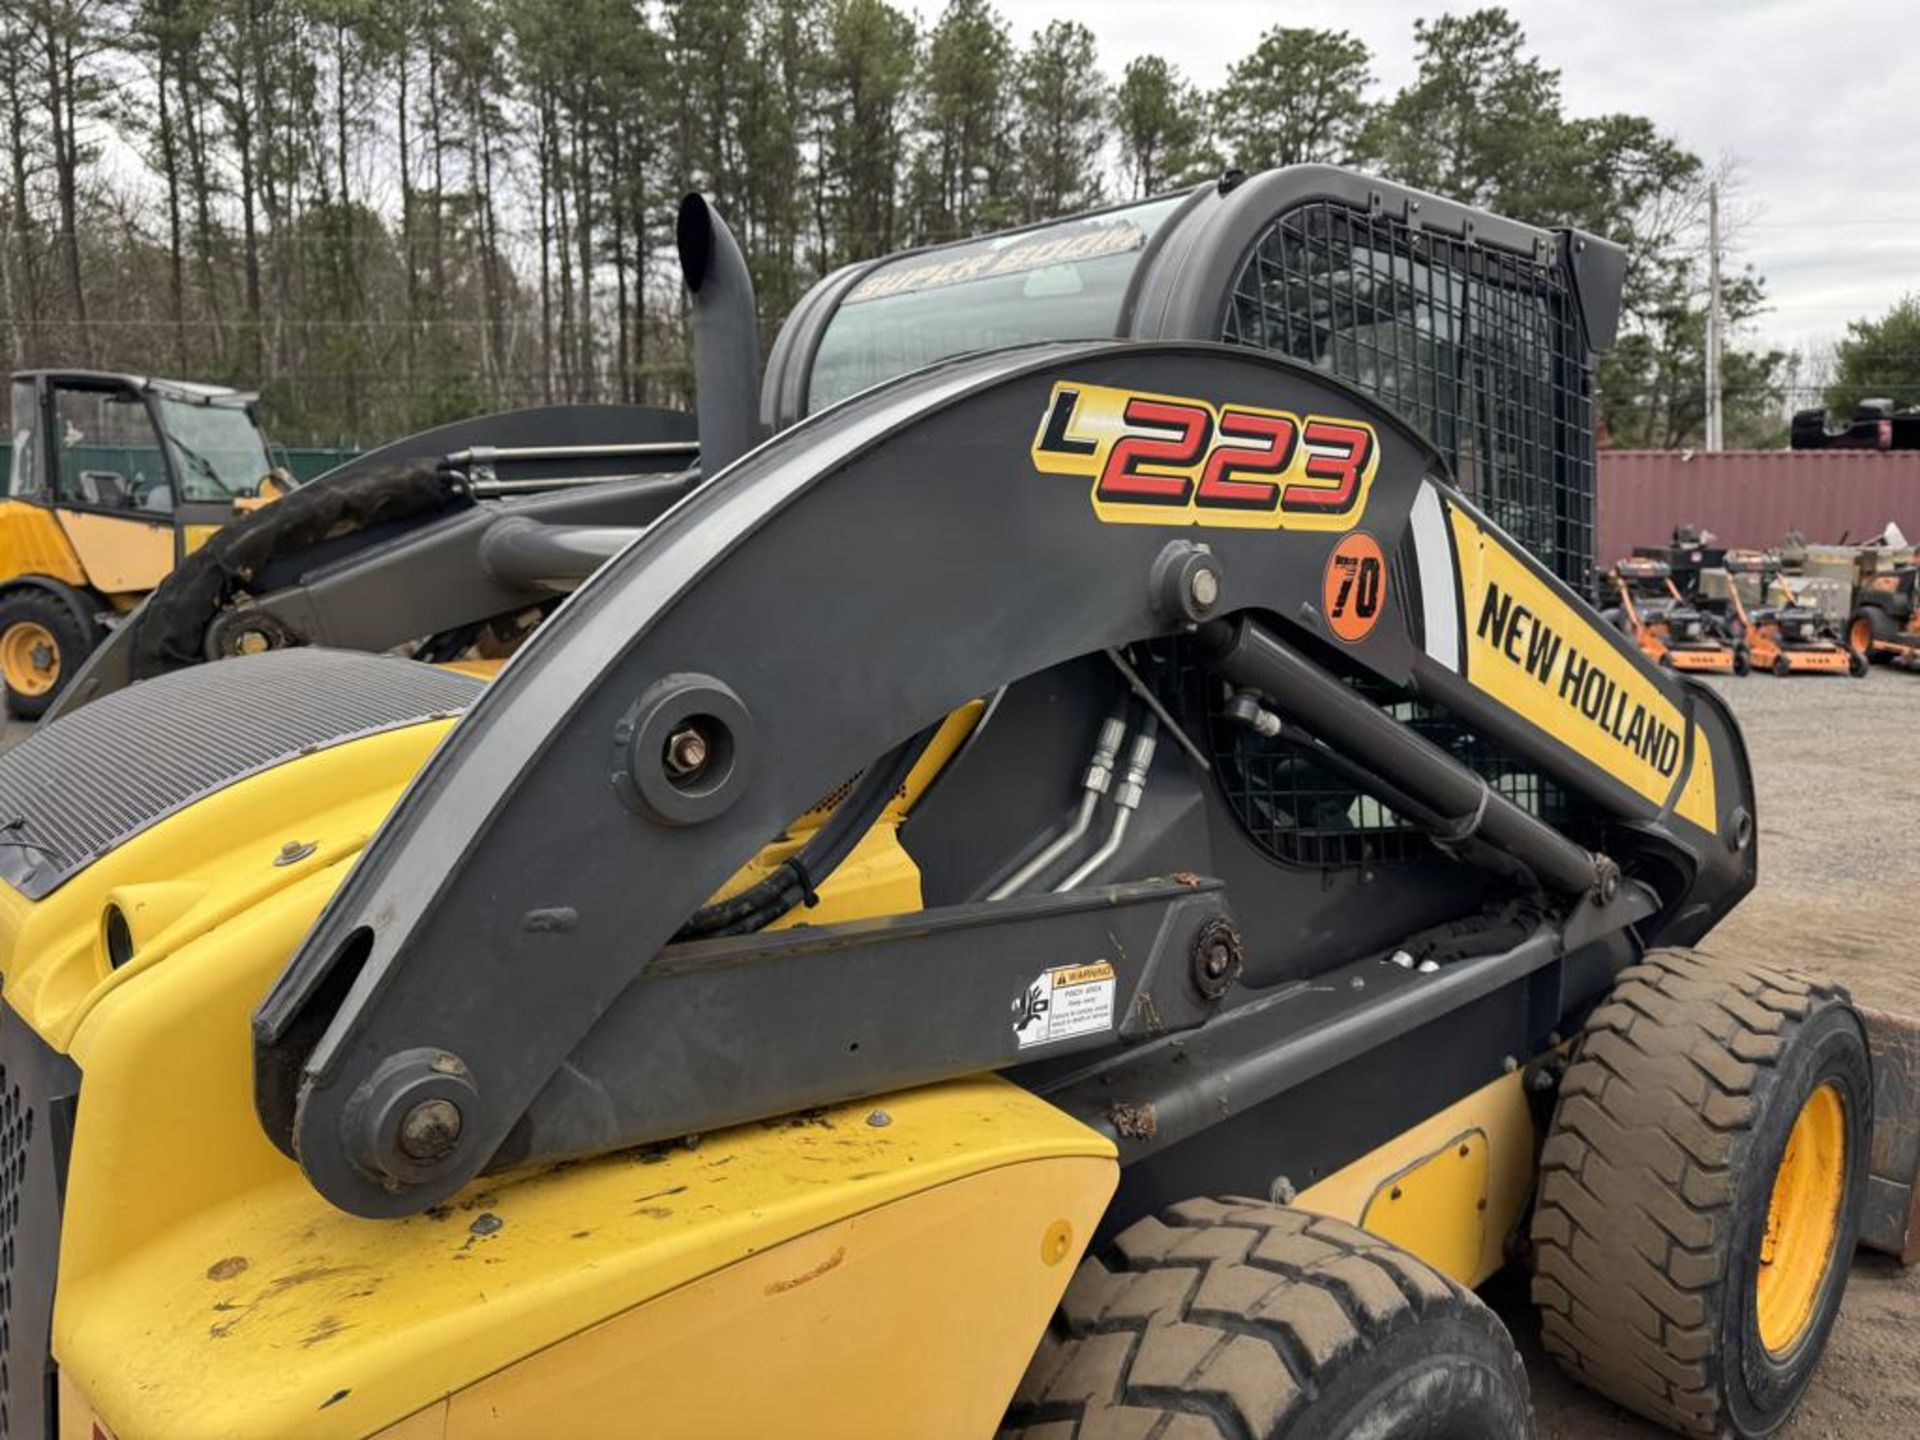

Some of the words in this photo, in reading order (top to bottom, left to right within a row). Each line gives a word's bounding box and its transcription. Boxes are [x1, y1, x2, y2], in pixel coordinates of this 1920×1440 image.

[1037, 389, 1374, 515] L223
[1331, 555, 1380, 618] 70
[1477, 581, 1562, 684] NEW
[1558, 648, 1680, 778] HOLLAND
[1068, 966, 1111, 981] WARNING
